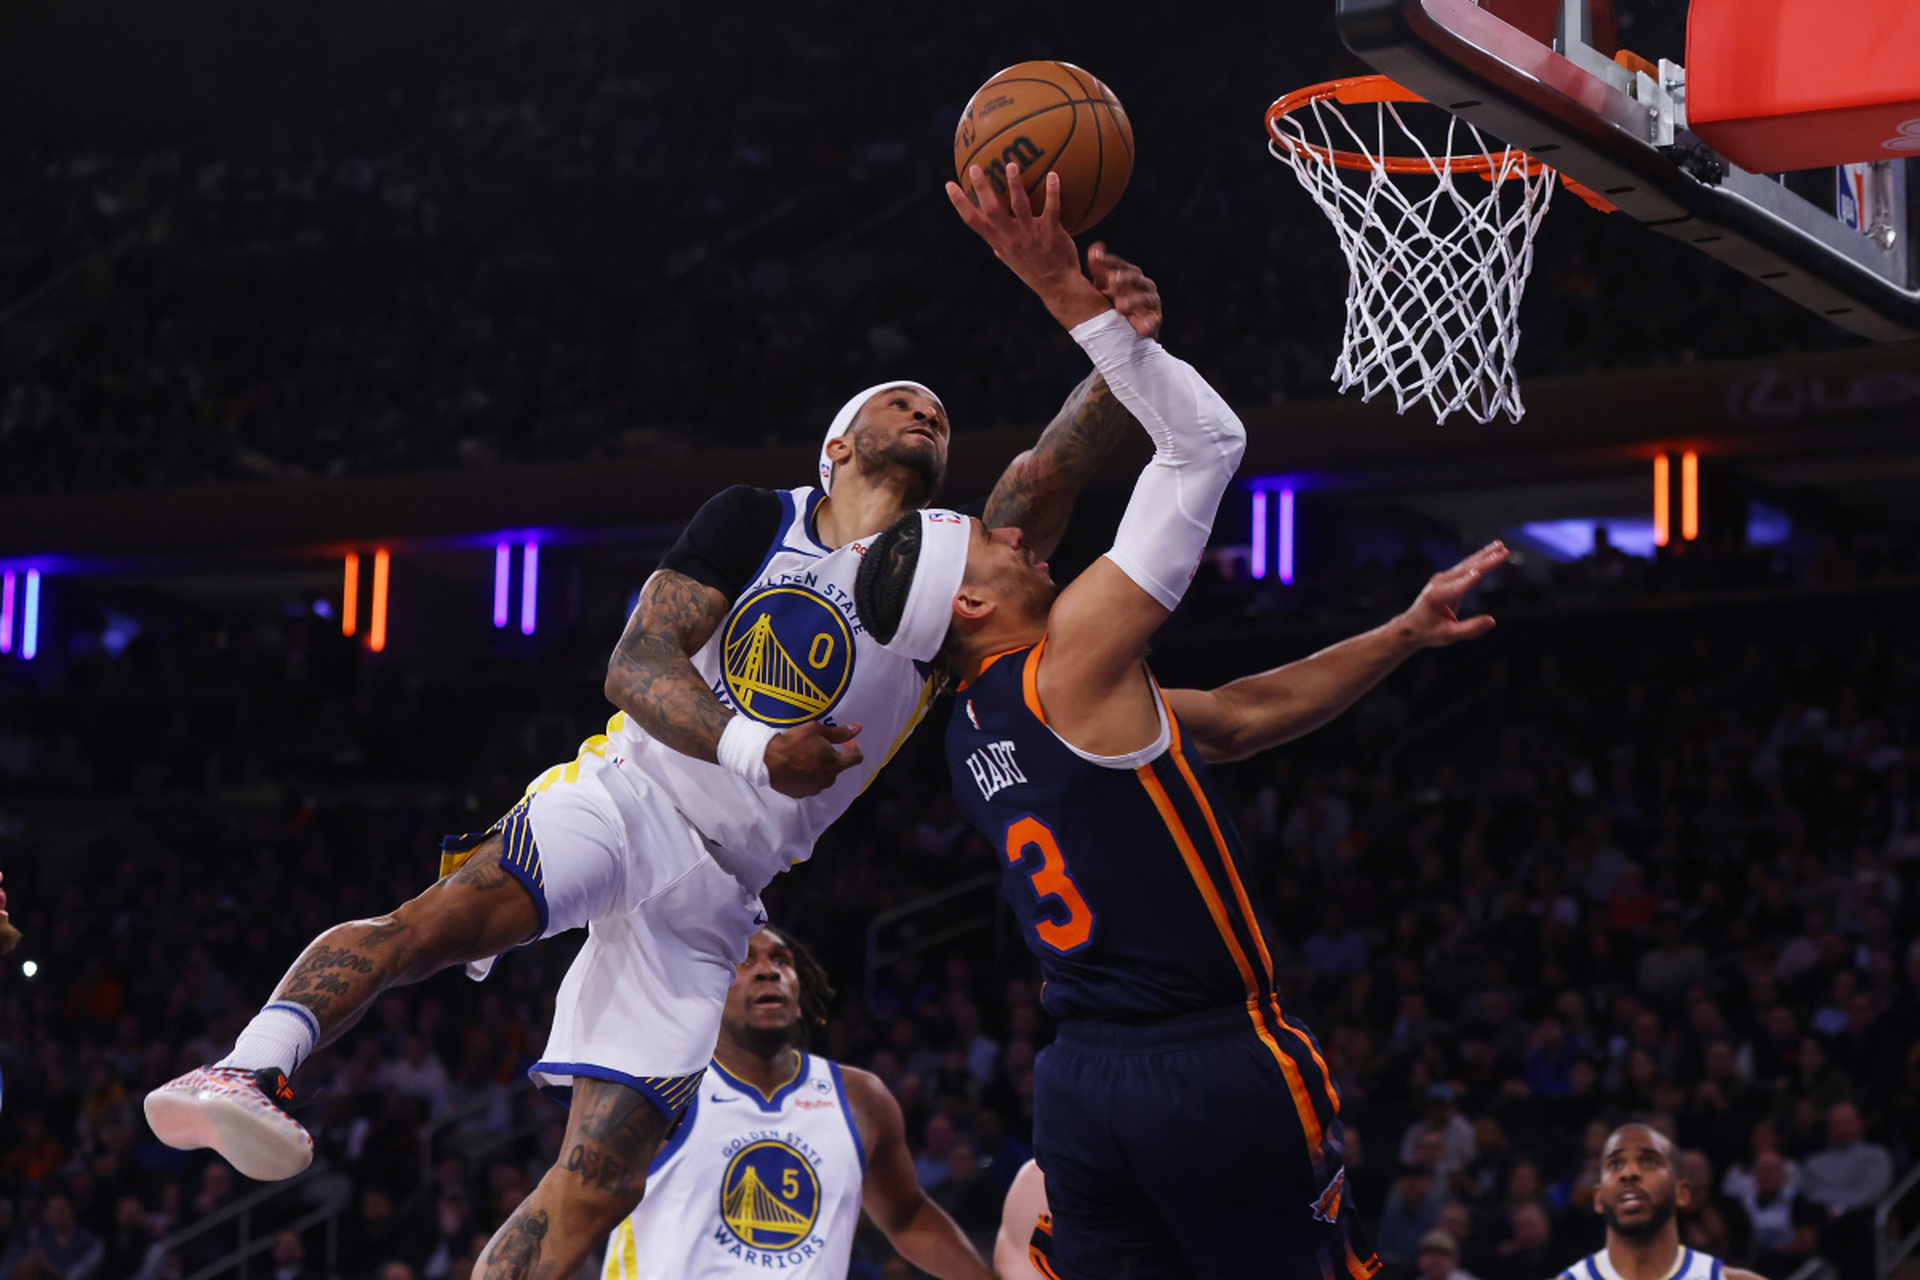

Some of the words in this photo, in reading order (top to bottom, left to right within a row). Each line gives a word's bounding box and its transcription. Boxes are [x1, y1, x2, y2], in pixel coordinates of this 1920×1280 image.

[823, 583, 866, 636] STATE
[808, 632, 835, 669] 0
[965, 740, 1028, 802] HART
[1004, 812, 1095, 956] 3
[722, 1130, 779, 1158] GOLDEN
[785, 1132, 823, 1168] STATE
[781, 1168, 800, 1200] 5
[713, 1224, 825, 1269] WARRIORS
